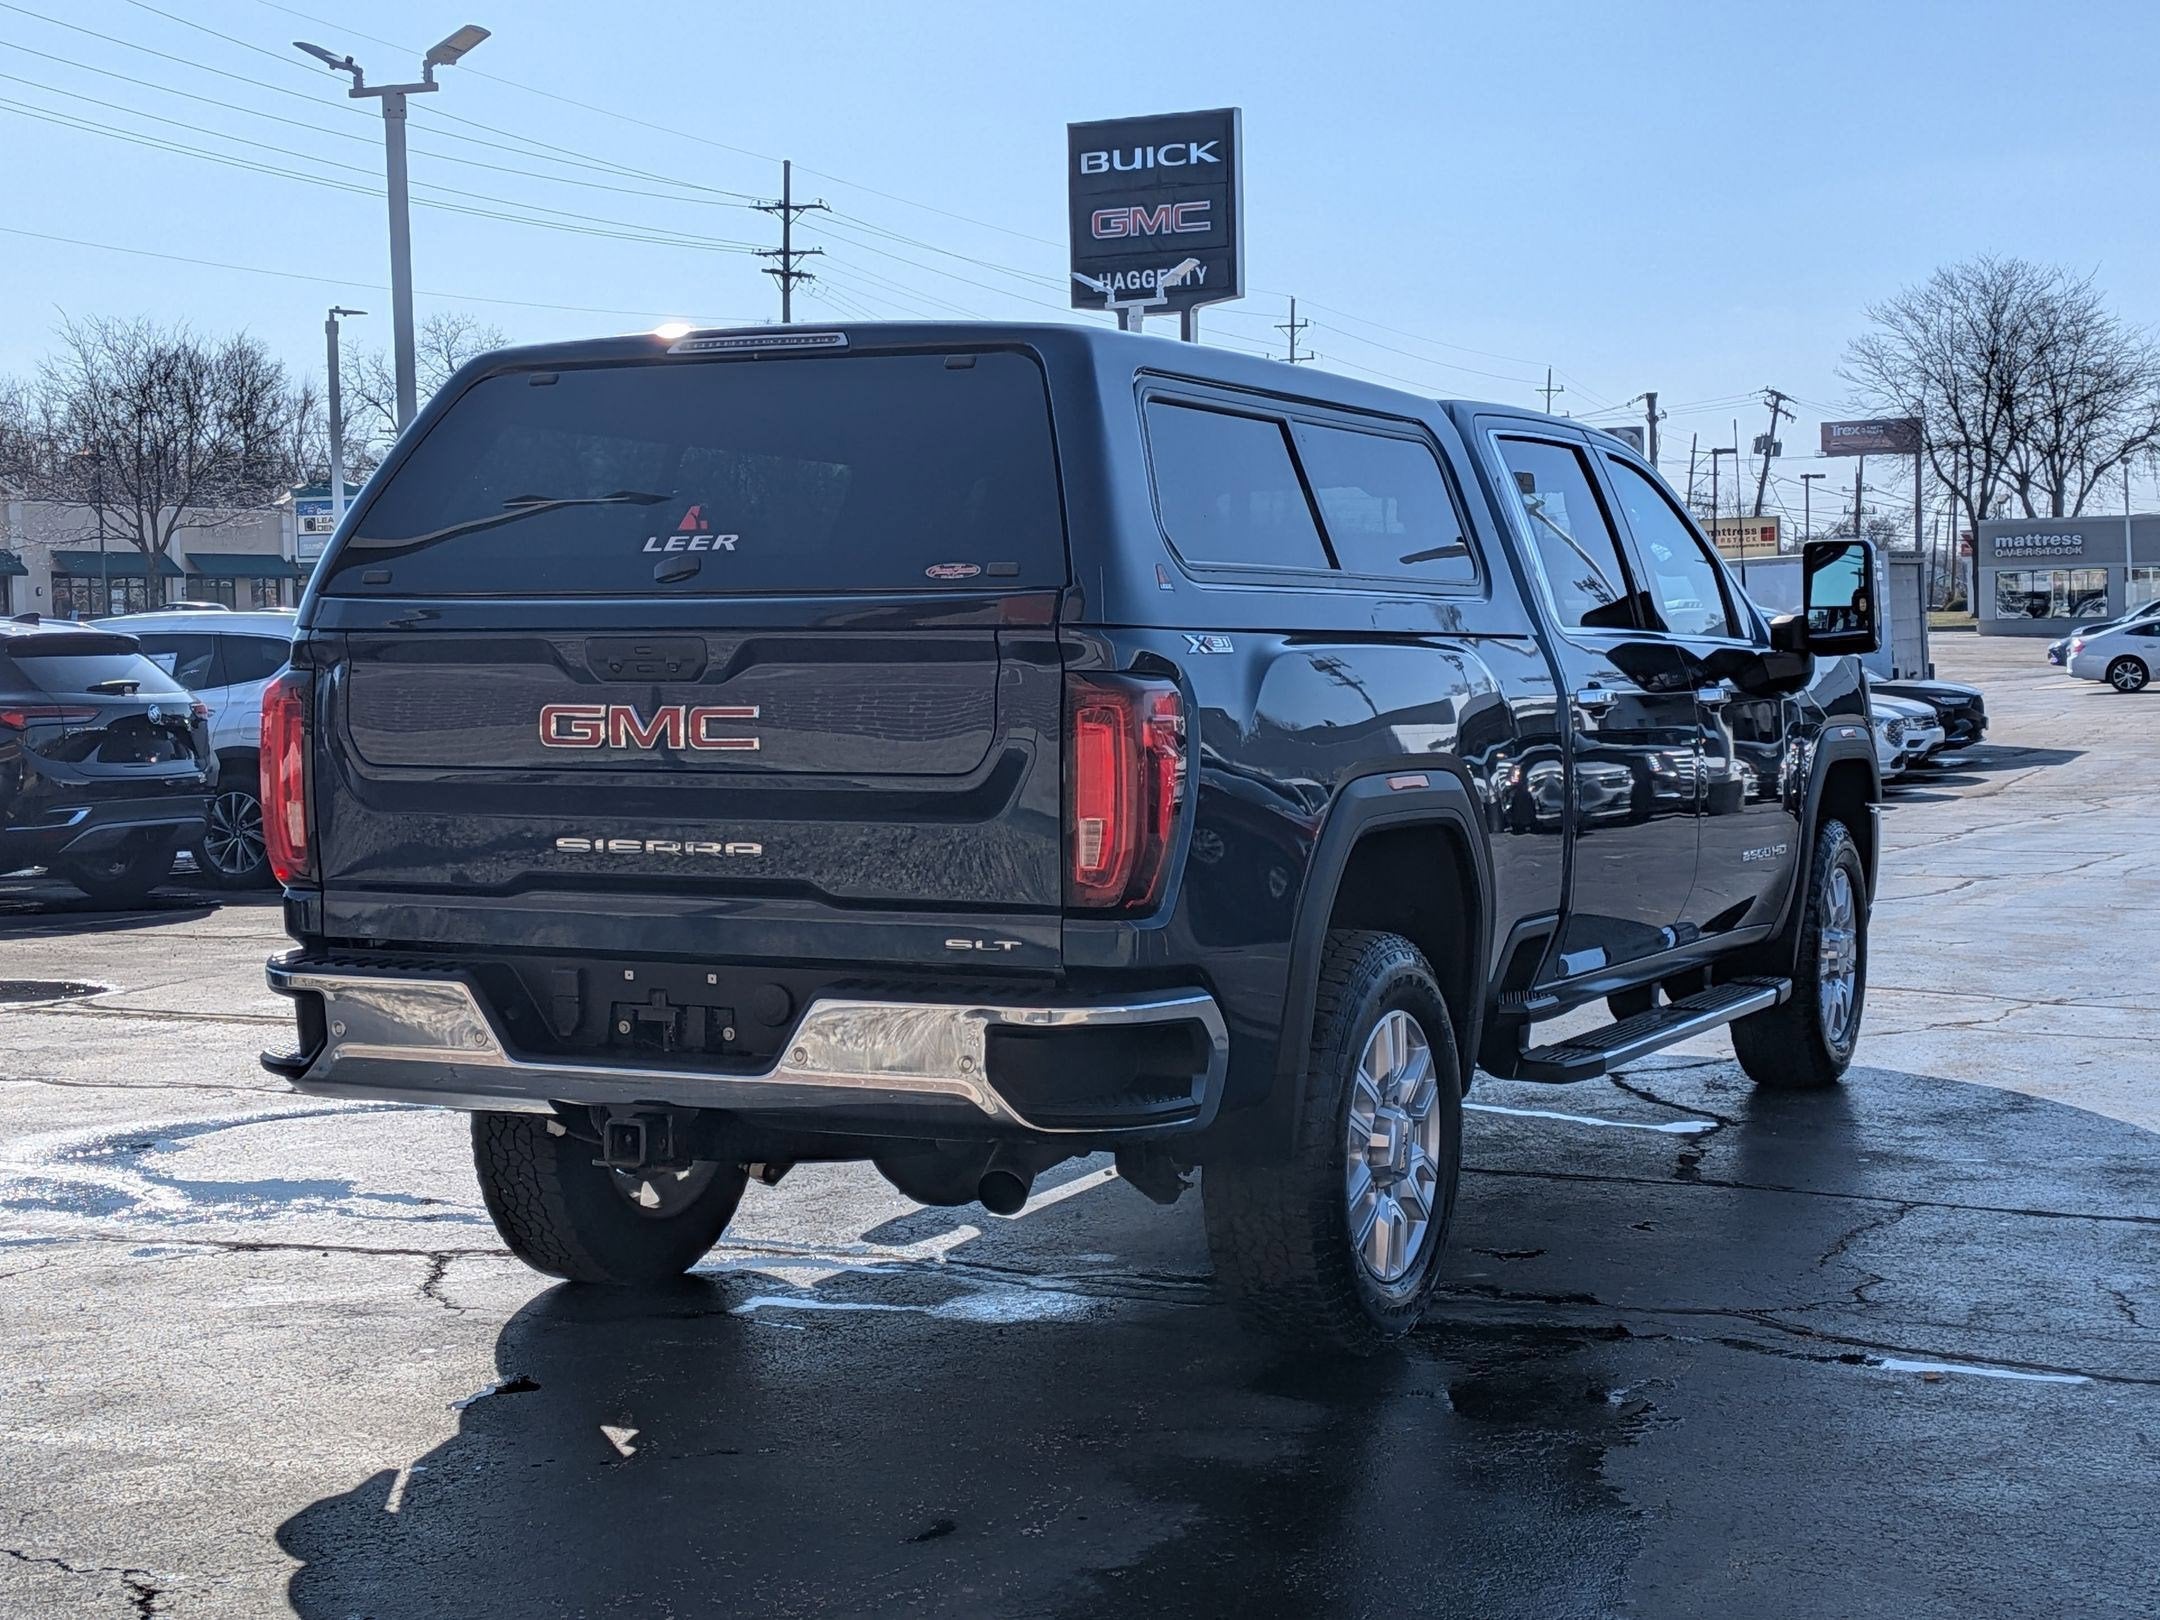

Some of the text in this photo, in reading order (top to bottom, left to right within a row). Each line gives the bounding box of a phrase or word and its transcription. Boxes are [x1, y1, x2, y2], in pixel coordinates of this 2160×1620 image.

[1080, 140, 1221, 174] BUICK
[1091, 200, 1211, 240] GMC
[1098, 265, 1207, 291] HAGGTY
[1831, 425, 1860, 436] Trex
[642, 534, 739, 552] LEER
[1995, 534, 2082, 547] mattress
[1995, 546, 2082, 557] OVERSTOCK
[539, 704, 760, 750] GMC
[556, 838, 763, 857] SIERRA
[945, 939, 1023, 951] SLT
